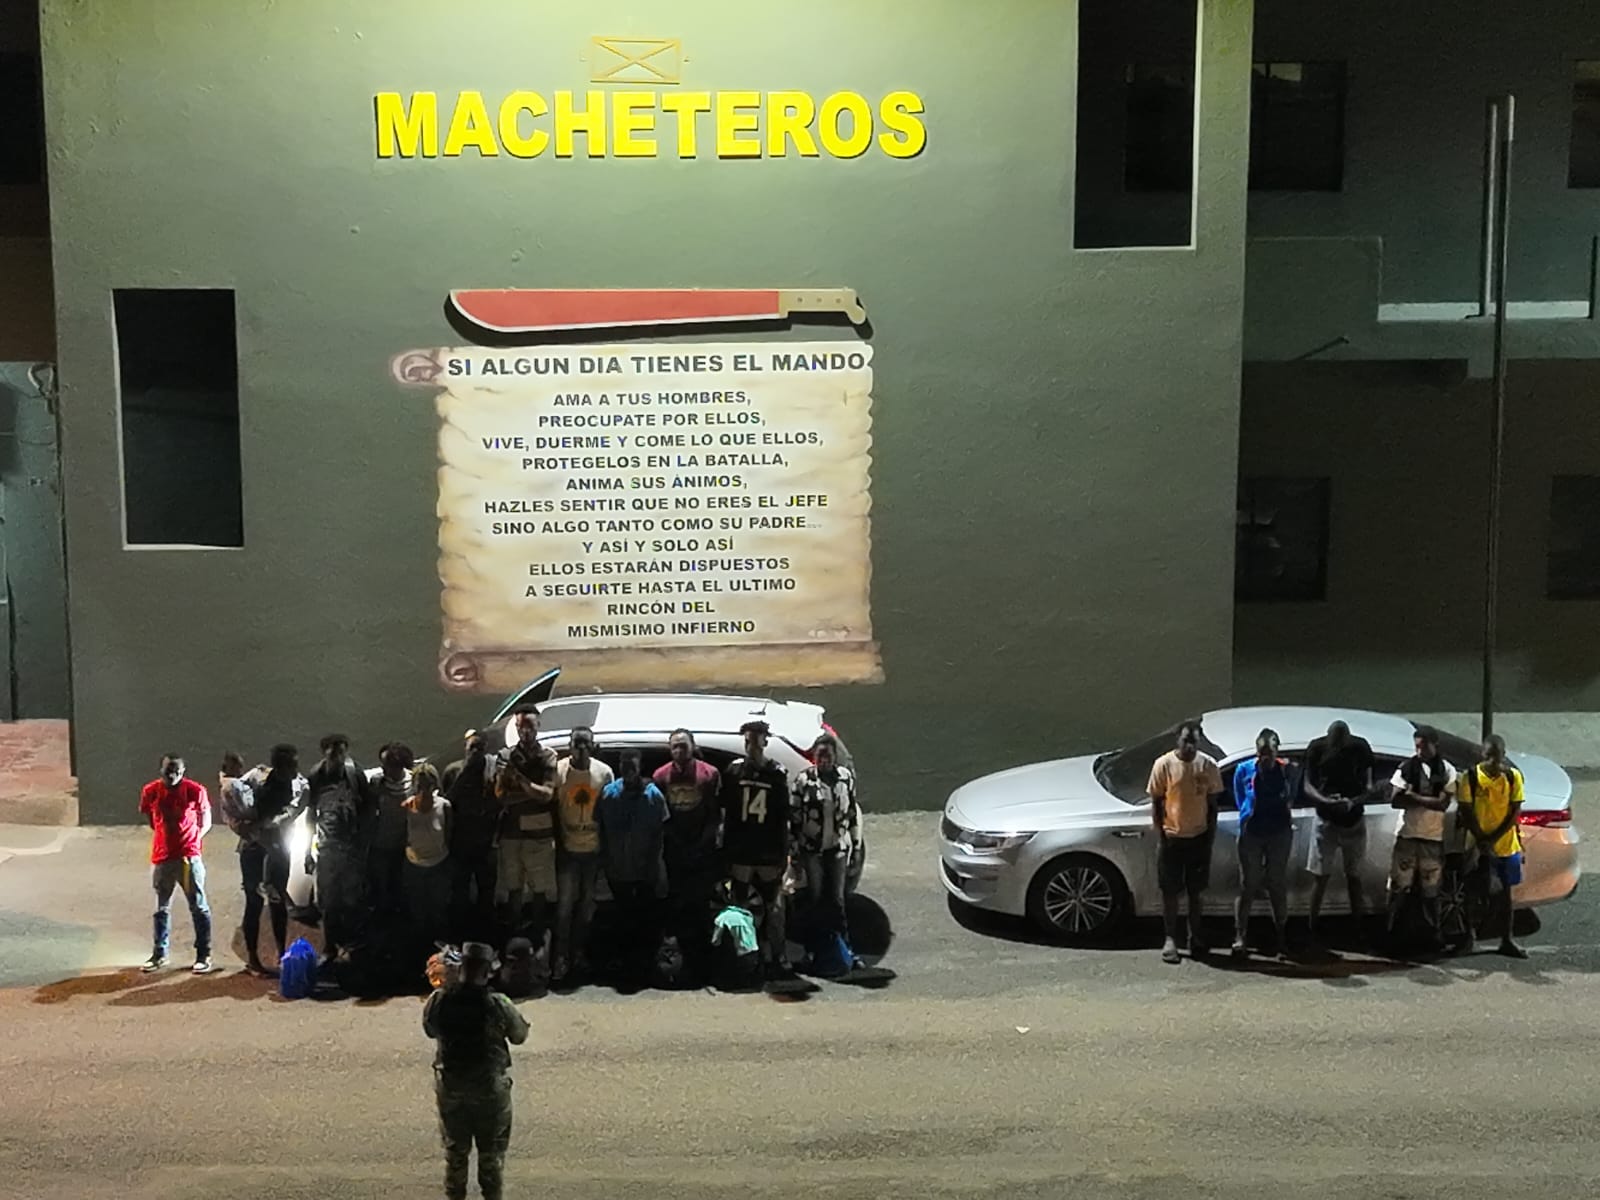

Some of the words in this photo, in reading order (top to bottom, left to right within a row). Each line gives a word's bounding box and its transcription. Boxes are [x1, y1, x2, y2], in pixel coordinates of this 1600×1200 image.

[375, 91, 927, 159] MACHETEROS
[447, 358, 472, 377] SI
[481, 357, 570, 376] ALGUN
[579, 356, 623, 374] DIA
[630, 354, 724, 374] TIENES
[733, 354, 764, 372] EL
[771, 352, 865, 372] MANDO
[552, 393, 593, 407] AMA
[598, 393, 611, 406] A
[615, 392, 652, 406] TUS
[657, 390, 751, 407] HOMBRES,
[538, 413, 656, 428] PREOCUPATE
[662, 412, 699, 427] POR
[704, 411, 766, 427] ELLOS,
[481, 436, 530, 452] VIVE,
[535, 435, 612, 450] DUERME
[616, 435, 629, 449] Y
[634, 434, 686, 448] COME
[690, 433, 714, 447] LO
[719, 432, 757, 446] QUE
[762, 431, 824, 447] ELLOS,
[522, 455, 641, 470] PROTEGELOS
[646, 454, 671, 468] EN
[676, 454, 700, 468] LA
[704, 452, 789, 468] BATALLA,
[565, 477, 625, 491] ANIMA
[630, 476, 666, 490] SUS
[484, 499, 555, 514] HAZLES
[559, 498, 626, 512] SENTIR
[631, 497, 669, 512] QUE
[674, 496, 700, 510] NO
[706, 495, 752, 509] ERES
[757, 495, 780, 509] EL
[784, 494, 828, 508] JEFE
[491, 521, 536, 535] SINO
[541, 520, 590, 534] ALGO
[594, 518, 655, 533] TANTO
[660, 517, 714, 532] COMO
[719, 516, 743, 530] SU
[581, 541, 594, 554] Y
[599, 537, 629, 554] ASÍ
[633, 539, 646, 553] Y
[651, 538, 700, 553] SOLO
[705, 535, 734, 552] ASÍ
[529, 562, 586, 576] ELLOS
[591, 557, 673, 575] ESTARÁN
[679, 557, 790, 573] DISPUESTOS
[525, 584, 538, 598] A
[542, 582, 633, 597] SEGUIRTE
[638, 580, 697, 595] HASTA
[702, 579, 724, 593] EL
[728, 577, 796, 592] ULTIMO
[607, 599, 676, 616] RINCÓN
[681, 600, 716, 614] DEL
[567, 622, 666, 638] MISMISIMO
[671, 620, 756, 635] INFIERNO
[742, 786, 767, 823] 14
